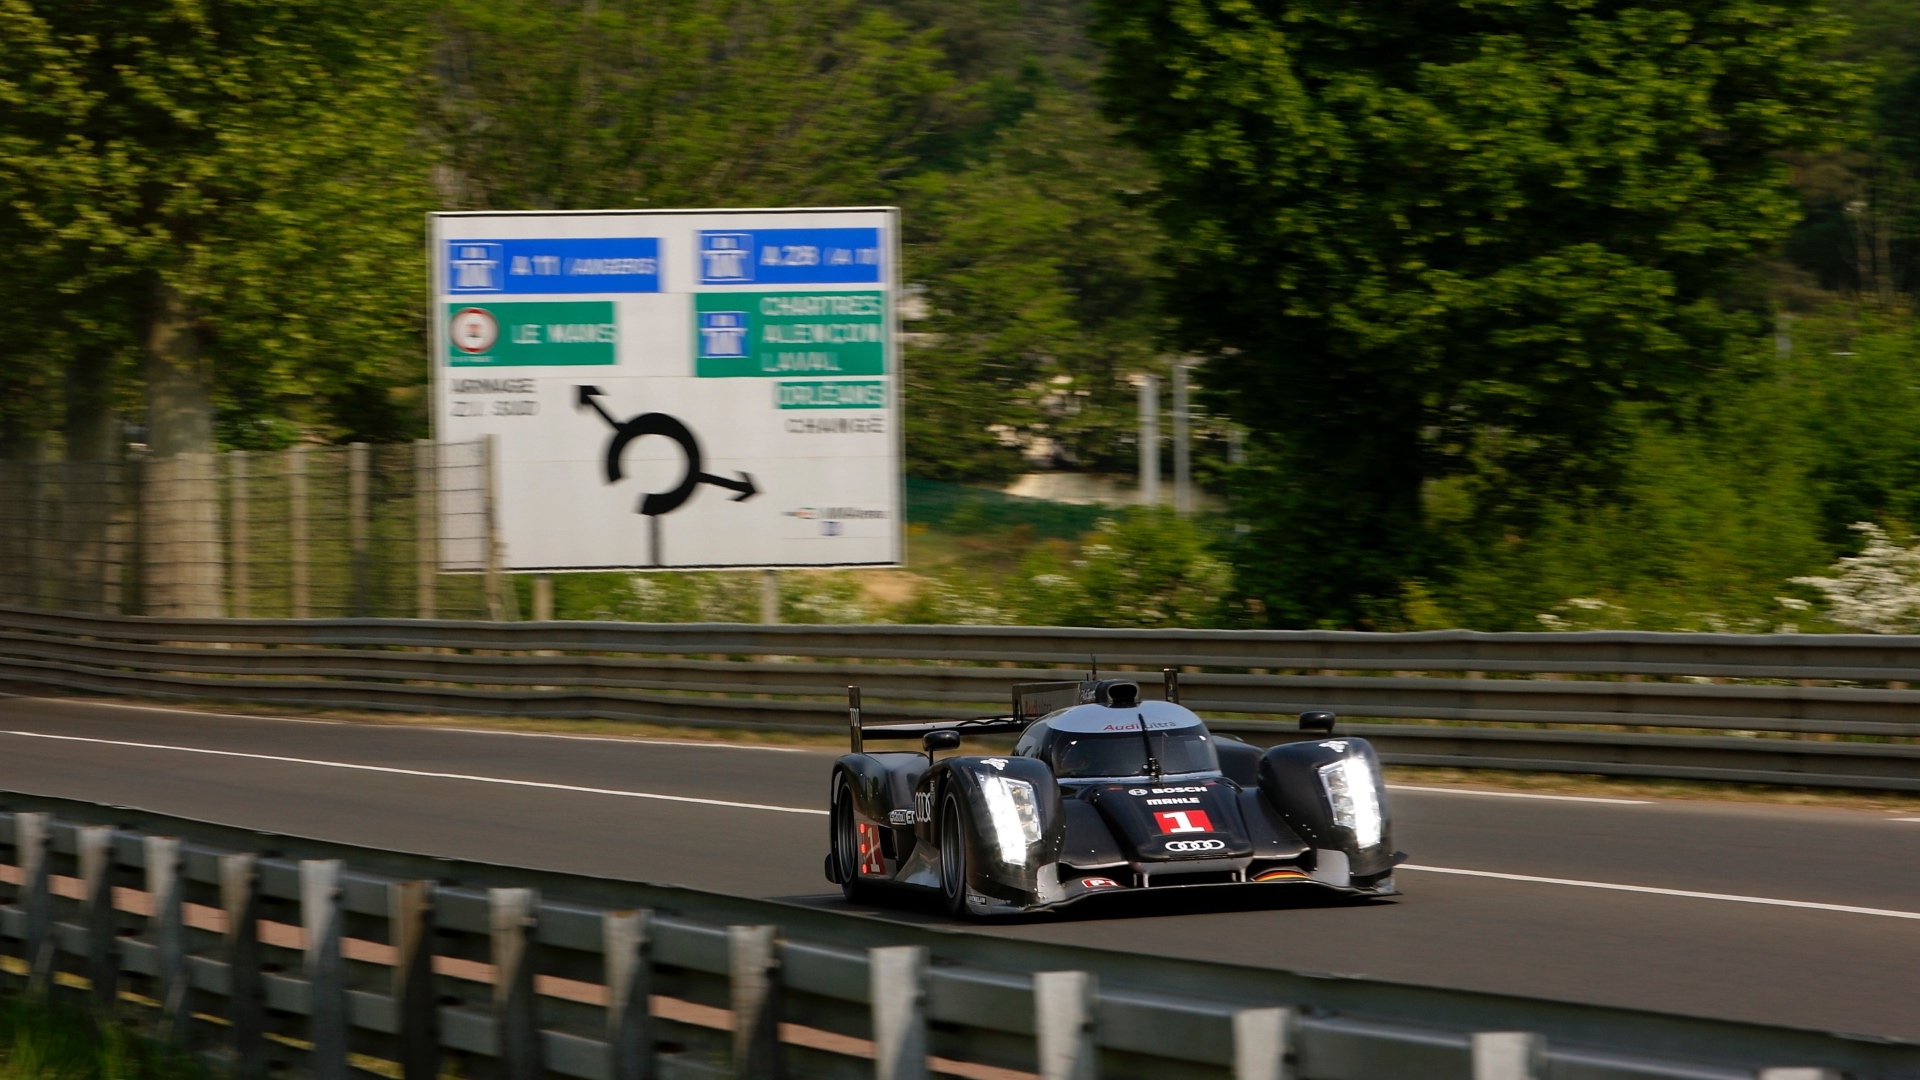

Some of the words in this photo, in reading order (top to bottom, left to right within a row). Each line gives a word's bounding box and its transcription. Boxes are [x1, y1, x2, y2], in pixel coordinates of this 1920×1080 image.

[759, 295, 882, 317] CHARTRES
[510, 324, 542, 345] LE
[546, 323, 617, 344] MANS
[761, 351, 843, 372] LAVAL
[1145, 721, 1176, 729] ultra
[1151, 786, 1208, 794] BOSCH
[1146, 797, 1200, 806] MAHLE
[1163, 811, 1205, 833] 1
[867, 826, 881, 873] 1
